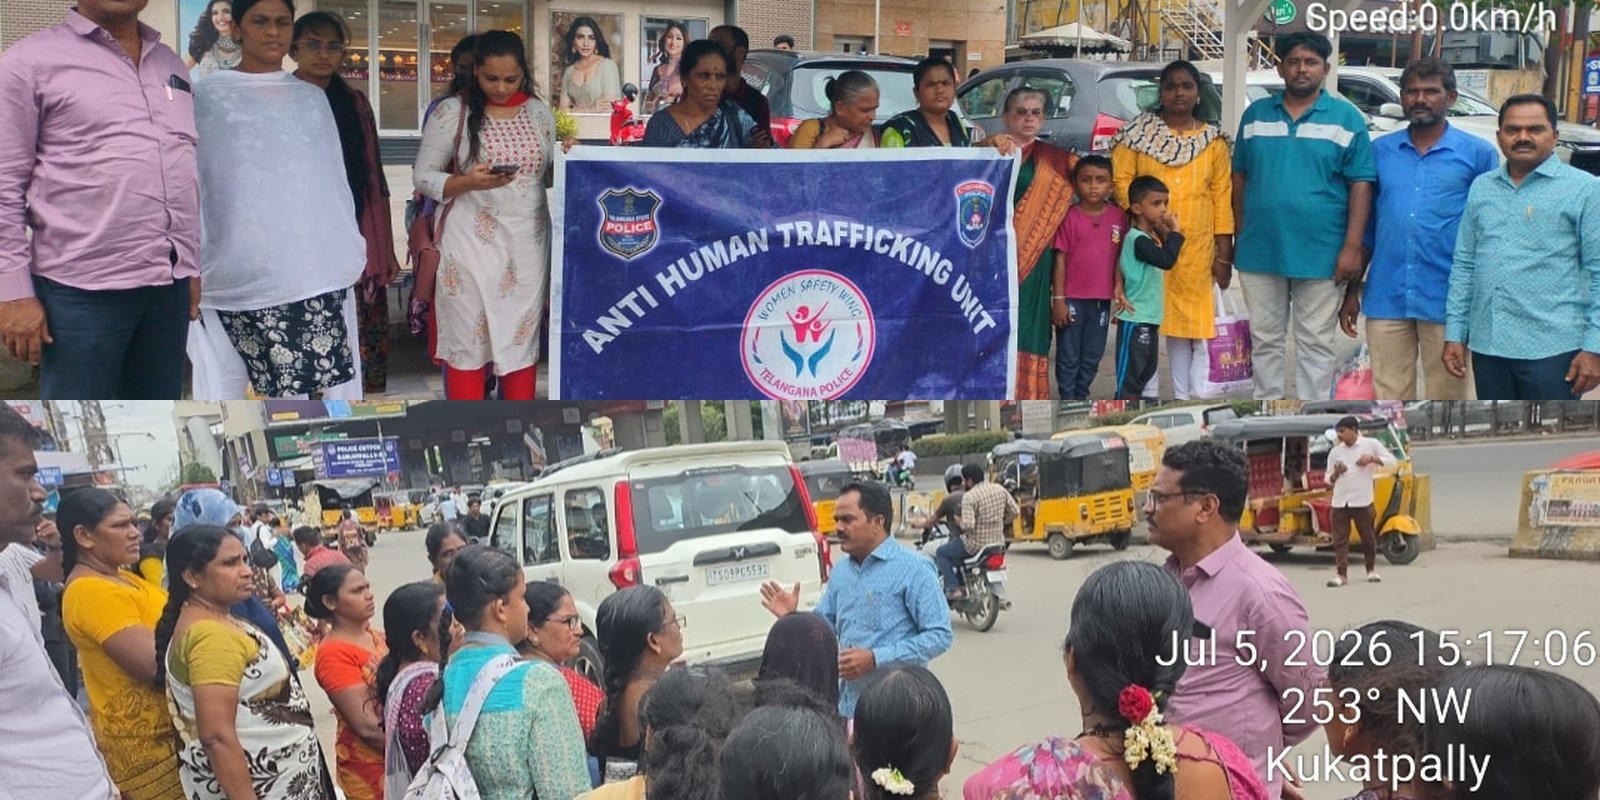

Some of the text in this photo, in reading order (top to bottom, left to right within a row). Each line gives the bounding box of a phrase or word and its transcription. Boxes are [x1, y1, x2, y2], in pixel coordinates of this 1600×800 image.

[605, 221, 652, 233] POLICE
[582, 220, 996, 354] ANTI HUMAN TRAFFICKING UNIT
[758, 279, 863, 320] WOMEN SAFETY WING
[760, 367, 853, 397] TELANGANA POLICE
